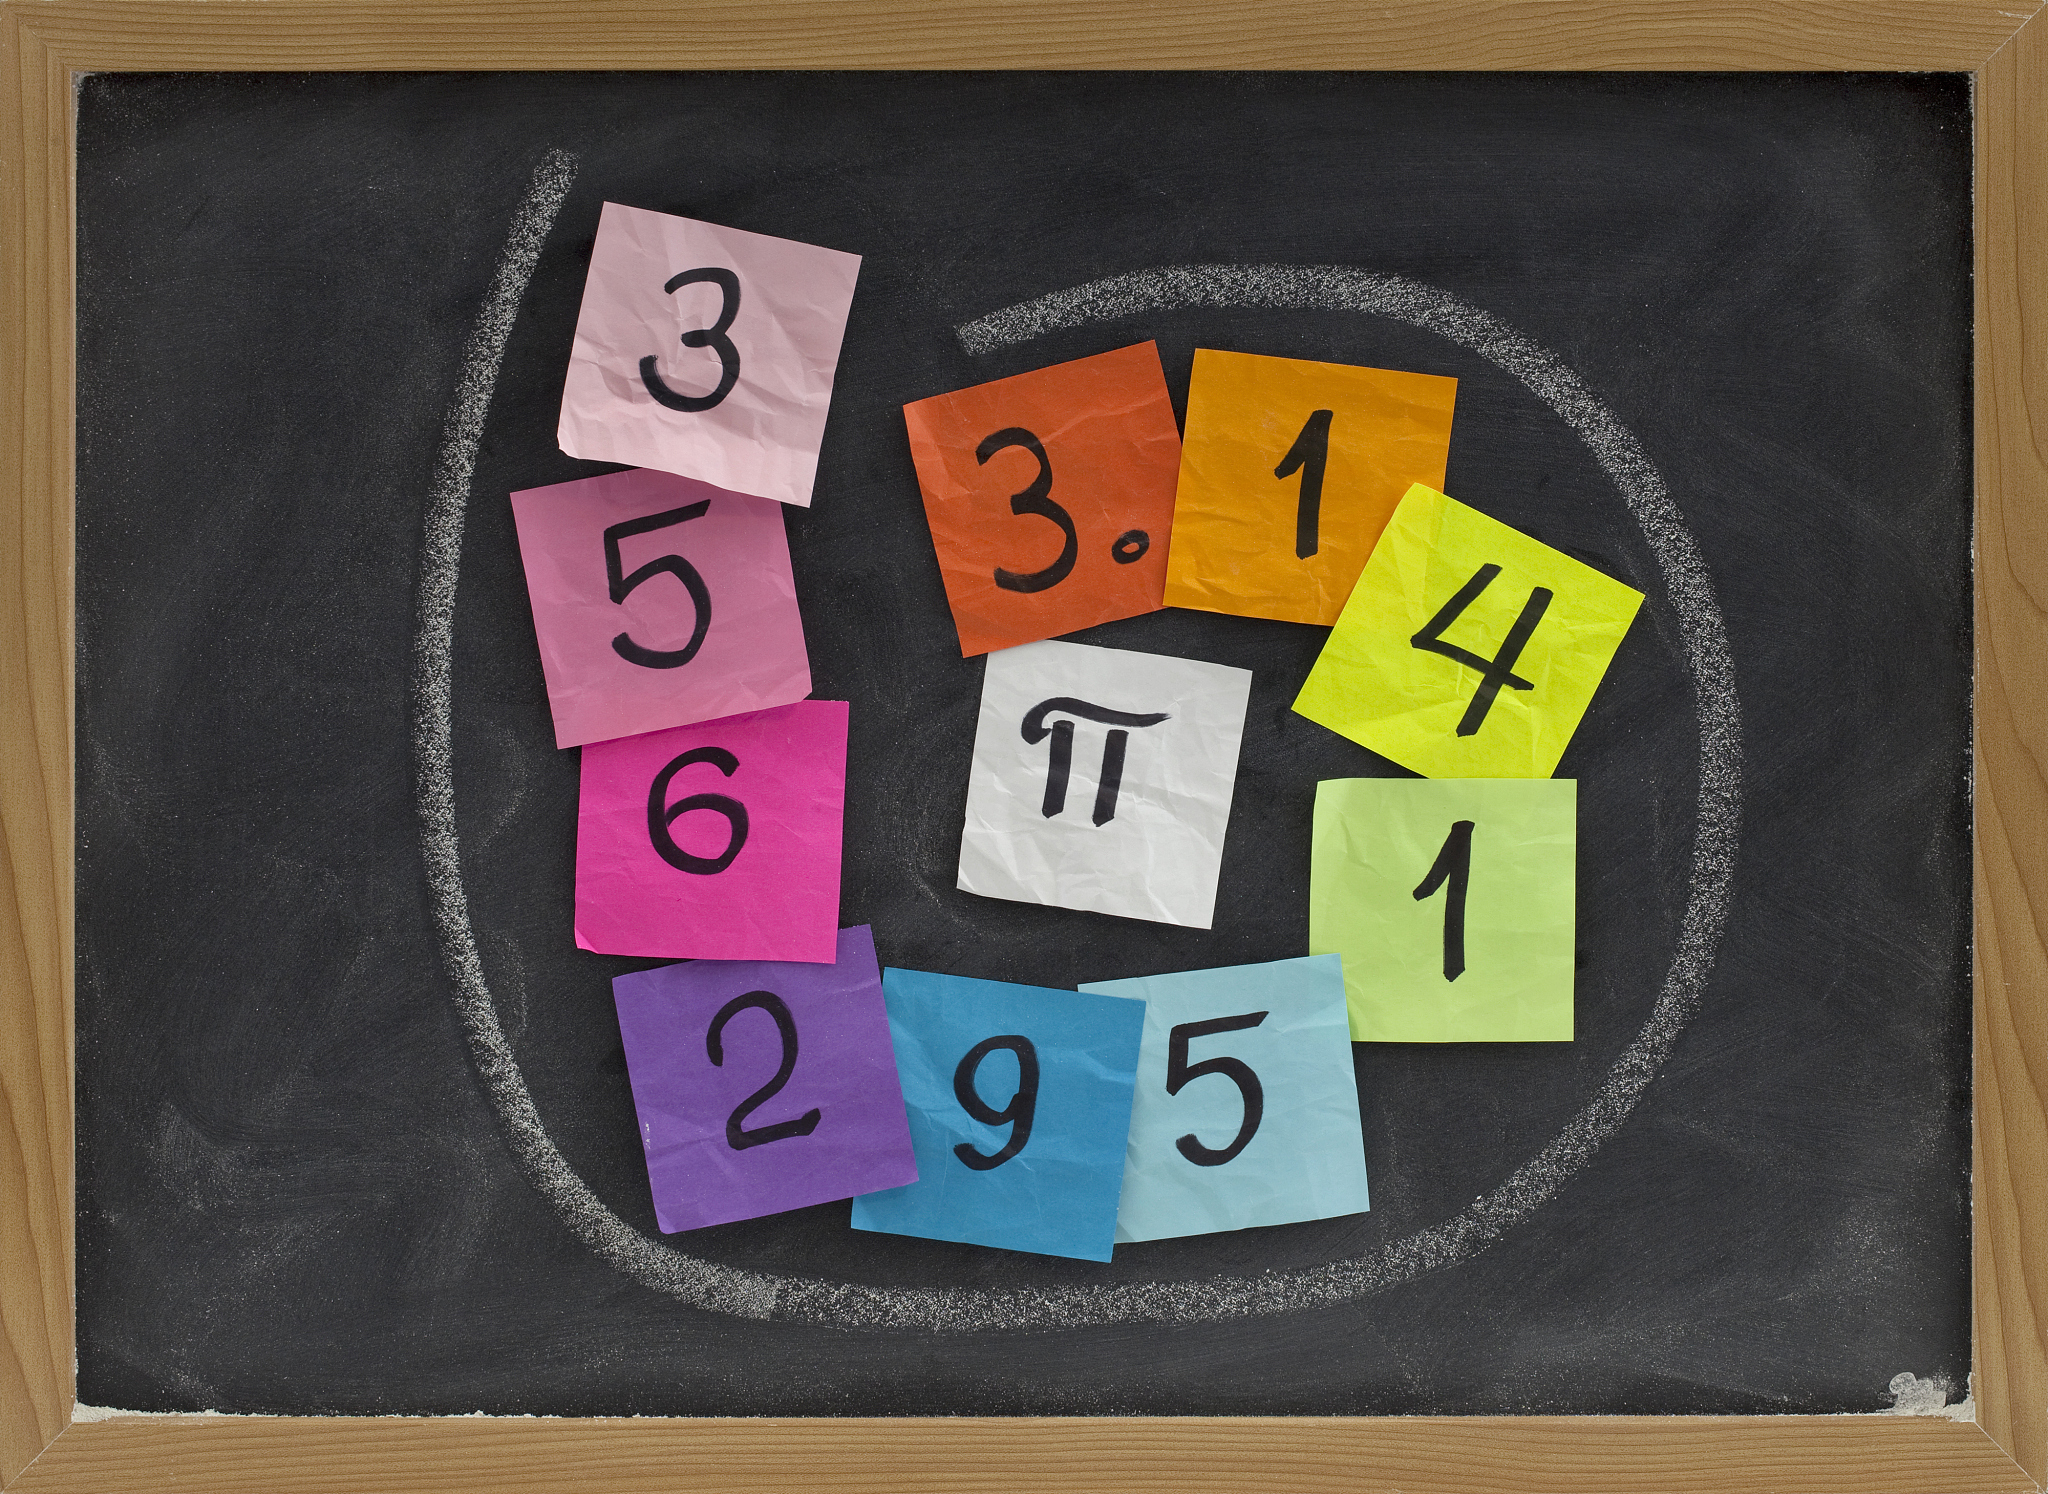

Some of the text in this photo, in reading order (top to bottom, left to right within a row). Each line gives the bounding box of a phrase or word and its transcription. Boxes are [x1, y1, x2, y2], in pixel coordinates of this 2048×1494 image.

[639, 268, 740, 412] 3
[1275, 410, 1333, 560] 1
[604, 499, 711, 669] 5
[1410, 563, 1553, 737] 4
[648, 747, 748, 875] 6
[1413, 821, 1475, 982] 1
[706, 991, 821, 1150] 2
[954, 1035, 1039, 1171] 9
[1166, 1011, 1269, 1166] 5
